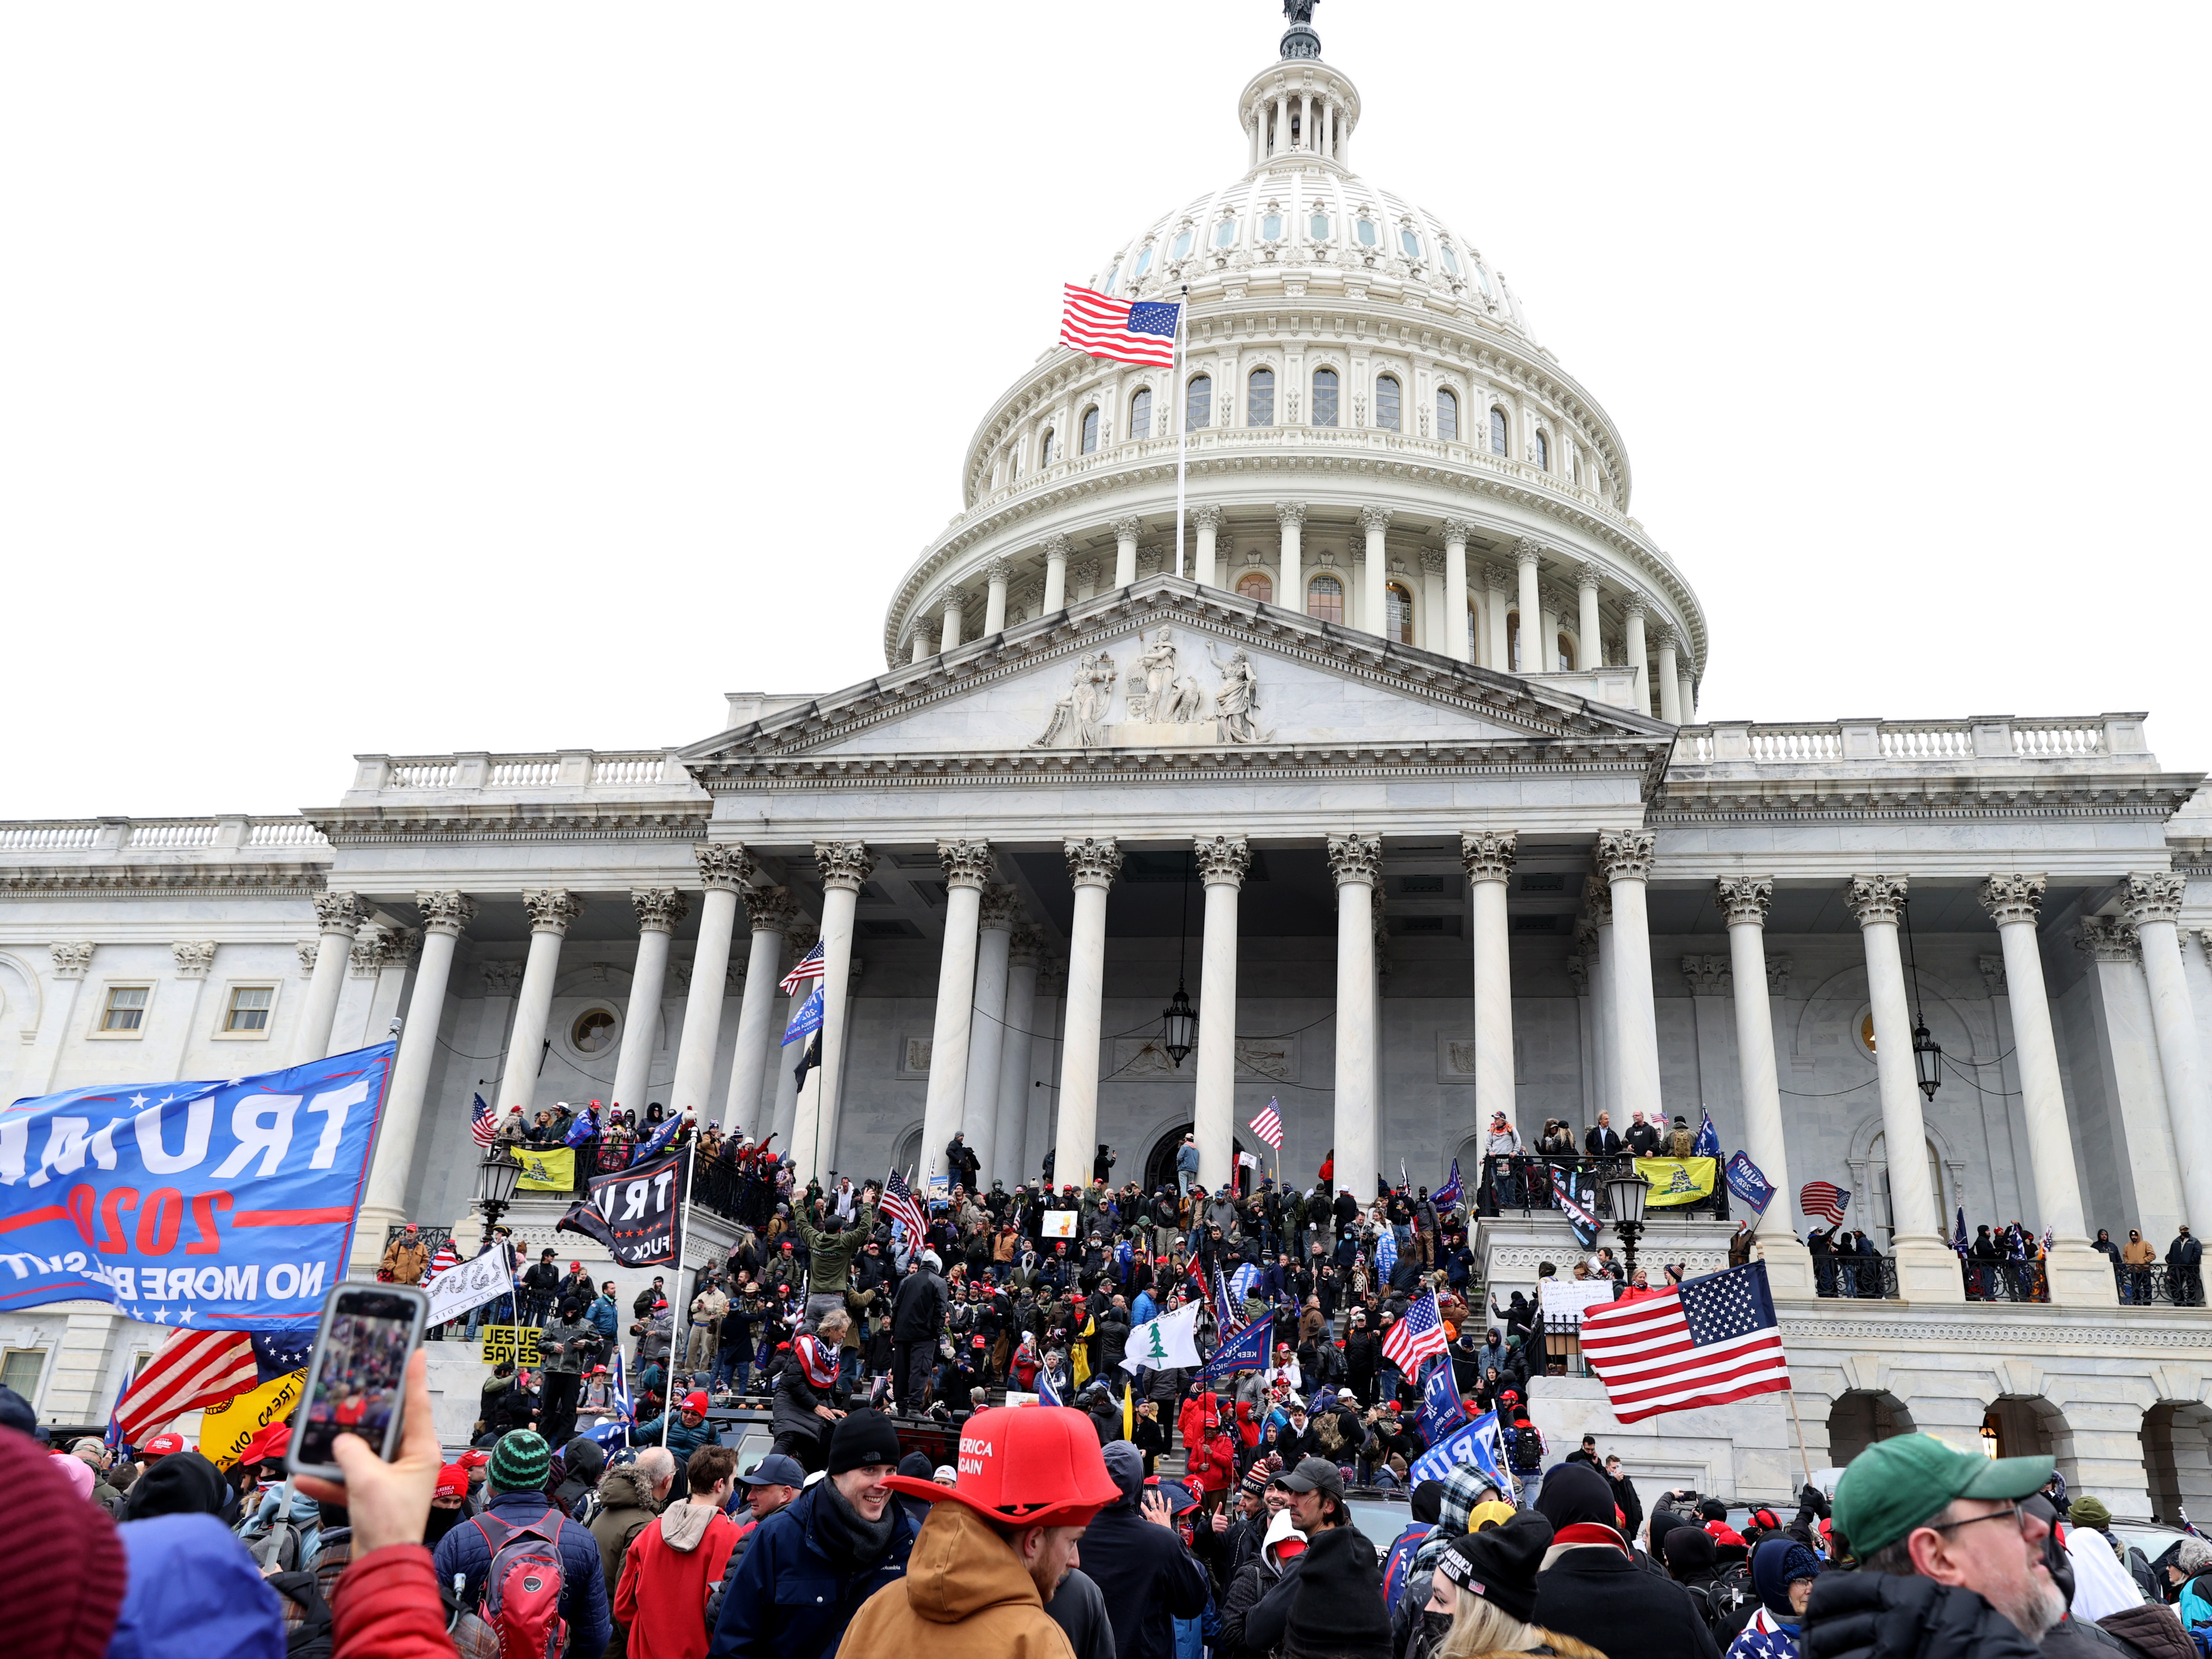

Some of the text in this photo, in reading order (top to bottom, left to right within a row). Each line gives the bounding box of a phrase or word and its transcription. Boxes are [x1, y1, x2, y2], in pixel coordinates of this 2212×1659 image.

[485, 1328, 540, 1346] JESUS
[483, 1345, 539, 1364] SAVES
[959, 1437, 993, 1457] MERICA
[437, 1485, 455, 1493] AMERICA
[1193, 1479, 1204, 1490] TRU
[1243, 1480, 1262, 1493] MAKE
[1444, 1547, 1473, 1577] MERICA
